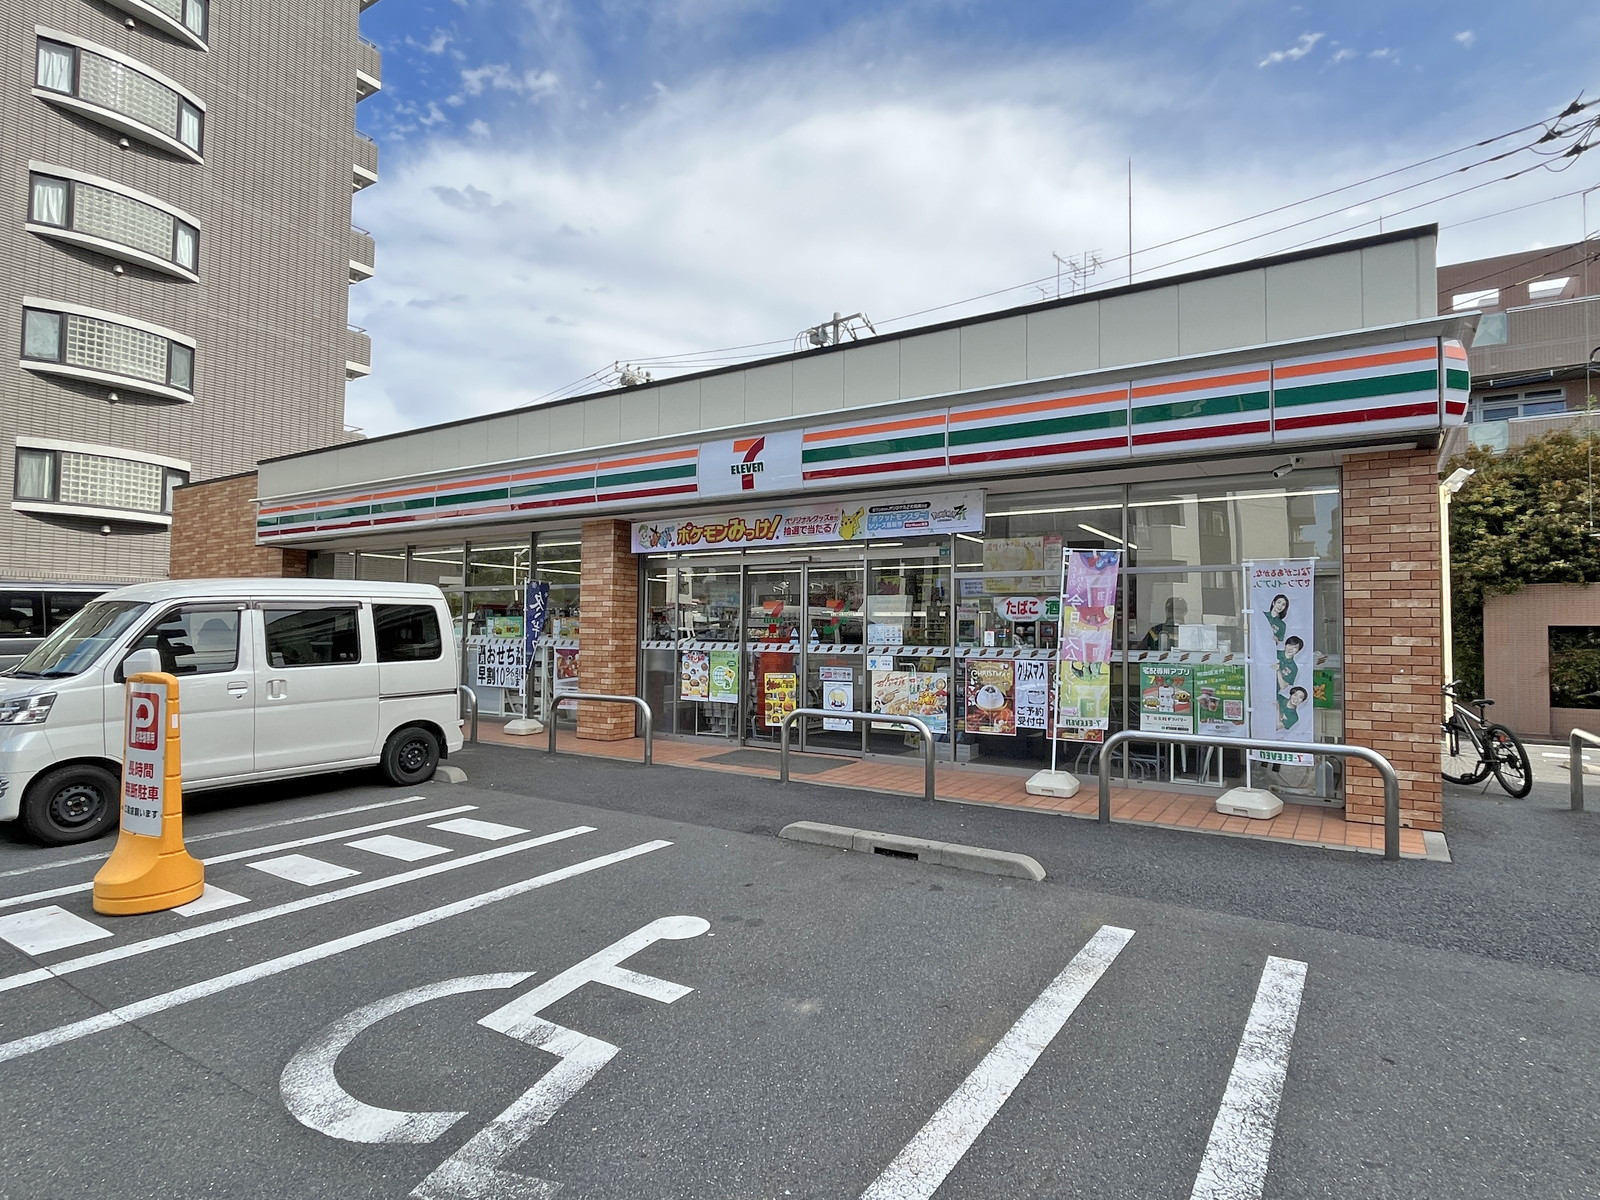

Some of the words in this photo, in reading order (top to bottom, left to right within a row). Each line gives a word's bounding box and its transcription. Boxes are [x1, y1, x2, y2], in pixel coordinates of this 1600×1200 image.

[733, 436, 765, 490] 7
[1006, 600, 1039, 615] たばこ
[1045, 600, 1060, 615] 酒
[1018, 662, 1045, 680] クリスマス
[1017, 706, 1044, 717] ご予約
[1017, 717, 1045, 728] 受付中
[128, 760, 154, 779] 長時間
[125, 781, 159, 802] 無断駐車
